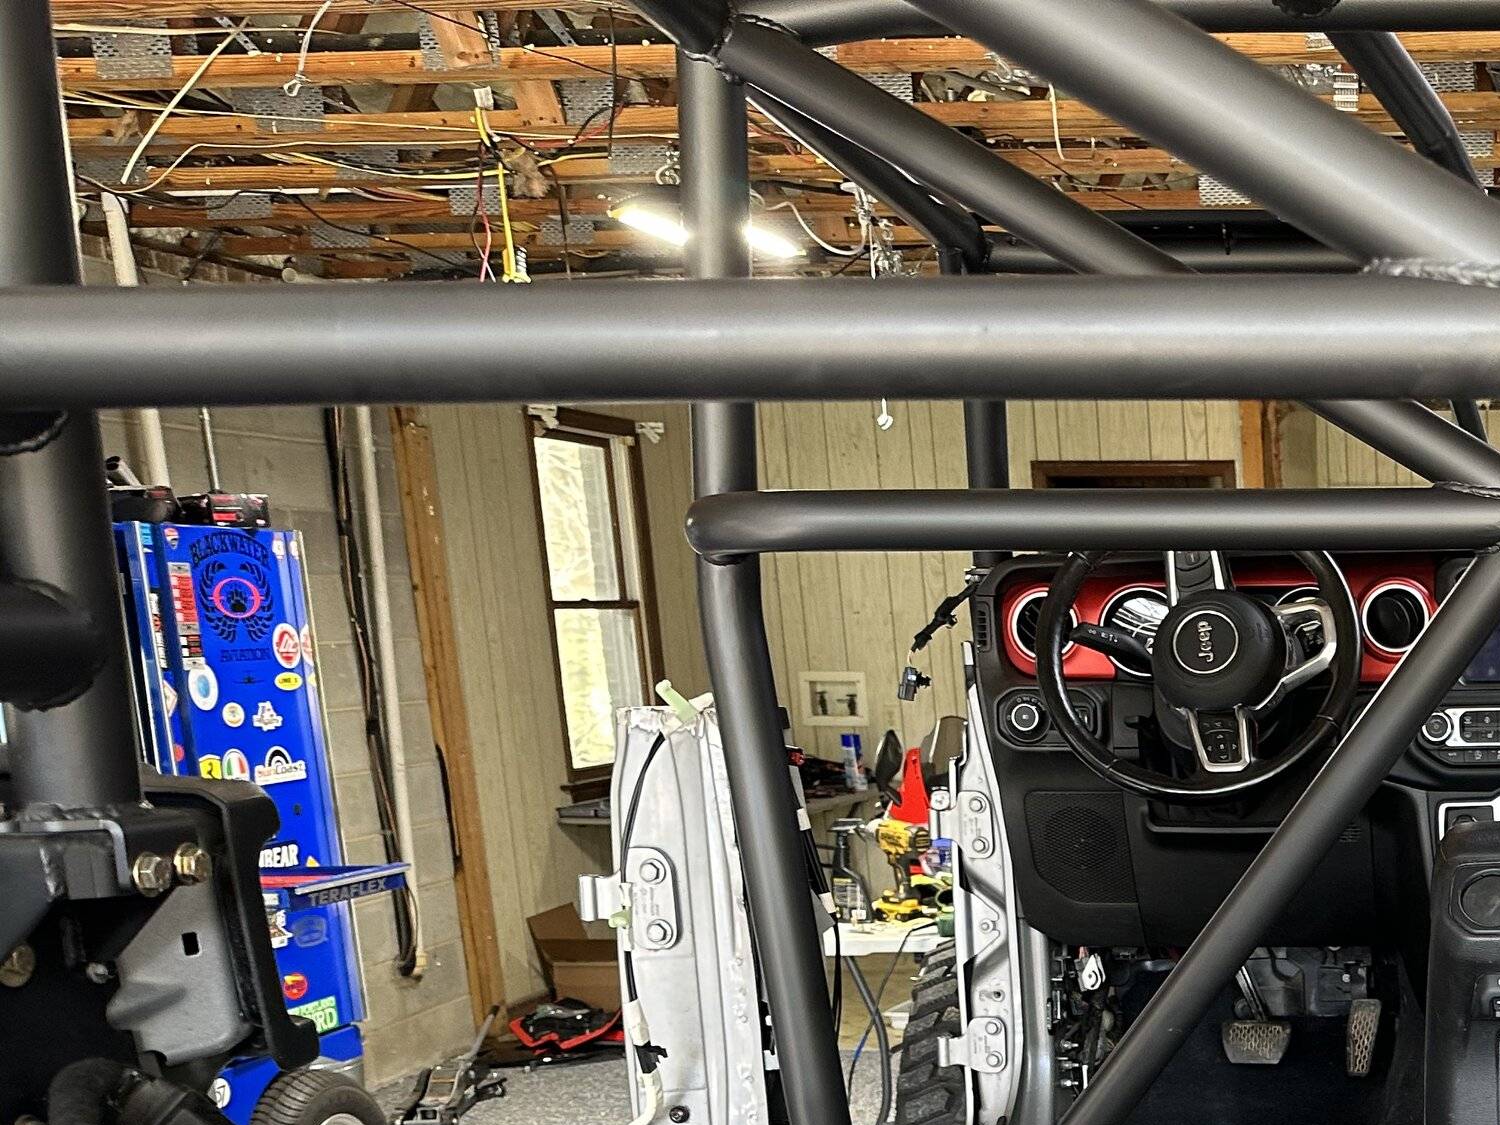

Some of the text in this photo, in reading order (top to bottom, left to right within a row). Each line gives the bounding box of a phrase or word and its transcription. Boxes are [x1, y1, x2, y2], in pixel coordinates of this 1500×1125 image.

[189, 531, 272, 569] BLACKWATER
[1197, 620, 1214, 663] Jeep
[308, 878, 386, 906] TERAFLEX
